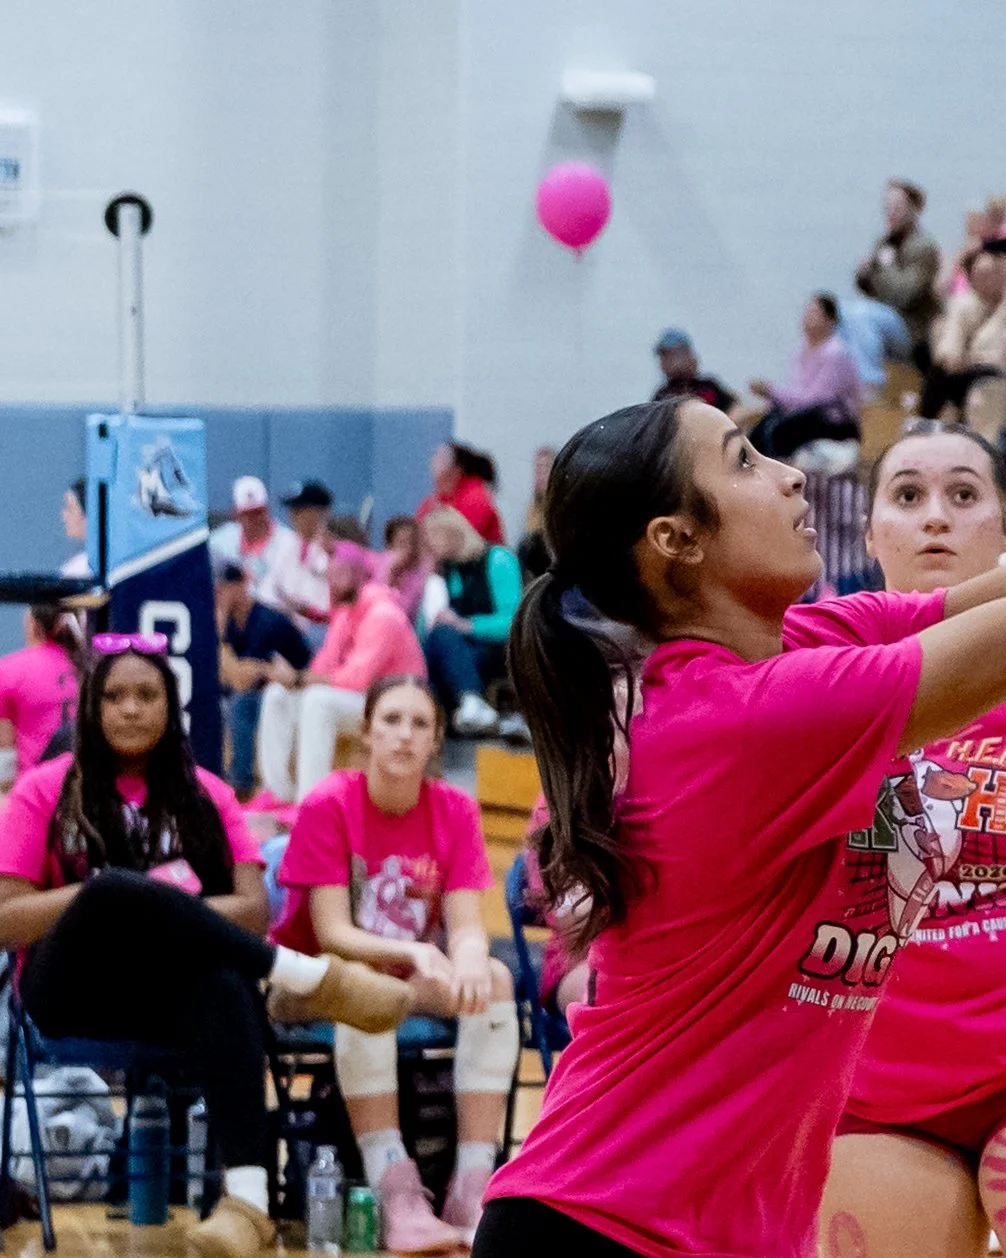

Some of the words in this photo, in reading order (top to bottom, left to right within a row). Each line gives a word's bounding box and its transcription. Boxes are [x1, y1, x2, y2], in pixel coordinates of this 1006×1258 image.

[909, 928, 946, 941] NITED
[798, 920, 899, 987] DIG
[788, 983, 830, 1006] RIVALS
